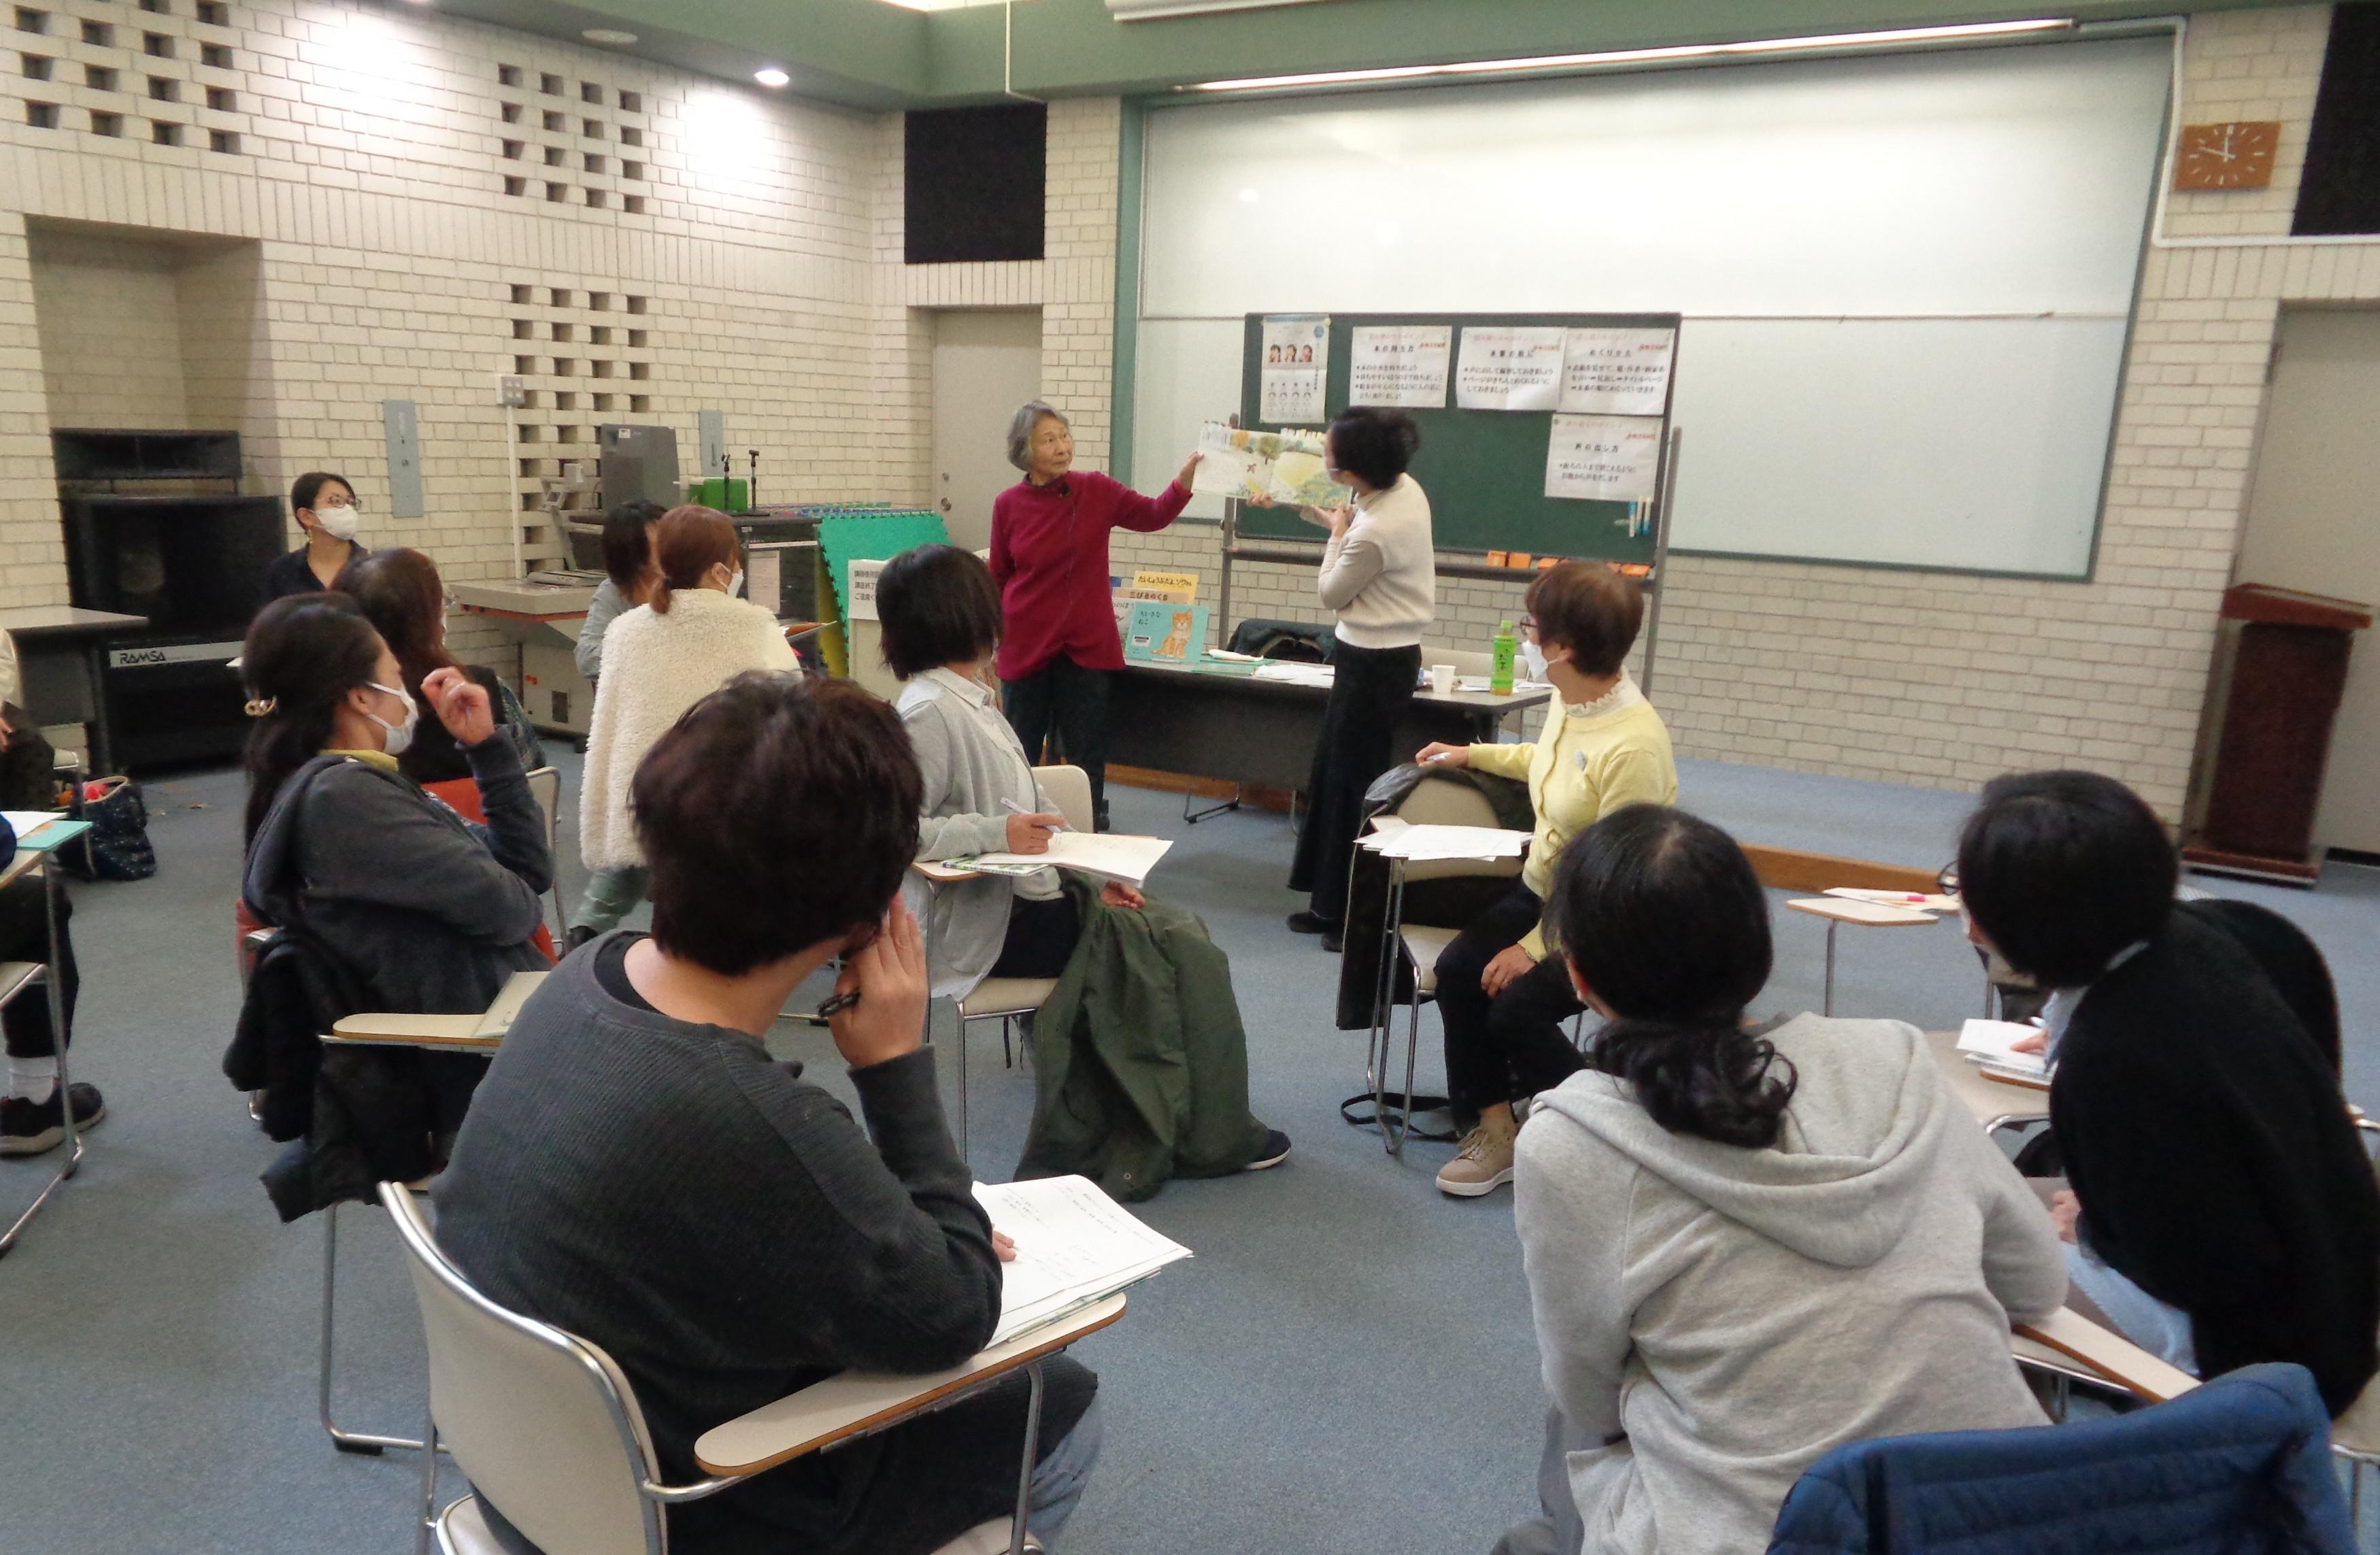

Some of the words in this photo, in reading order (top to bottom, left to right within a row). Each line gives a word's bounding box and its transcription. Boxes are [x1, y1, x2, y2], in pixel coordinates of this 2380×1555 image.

[1130, 591, 1168, 601] 三びきのくま
[120, 650, 166, 664] RAMSA
